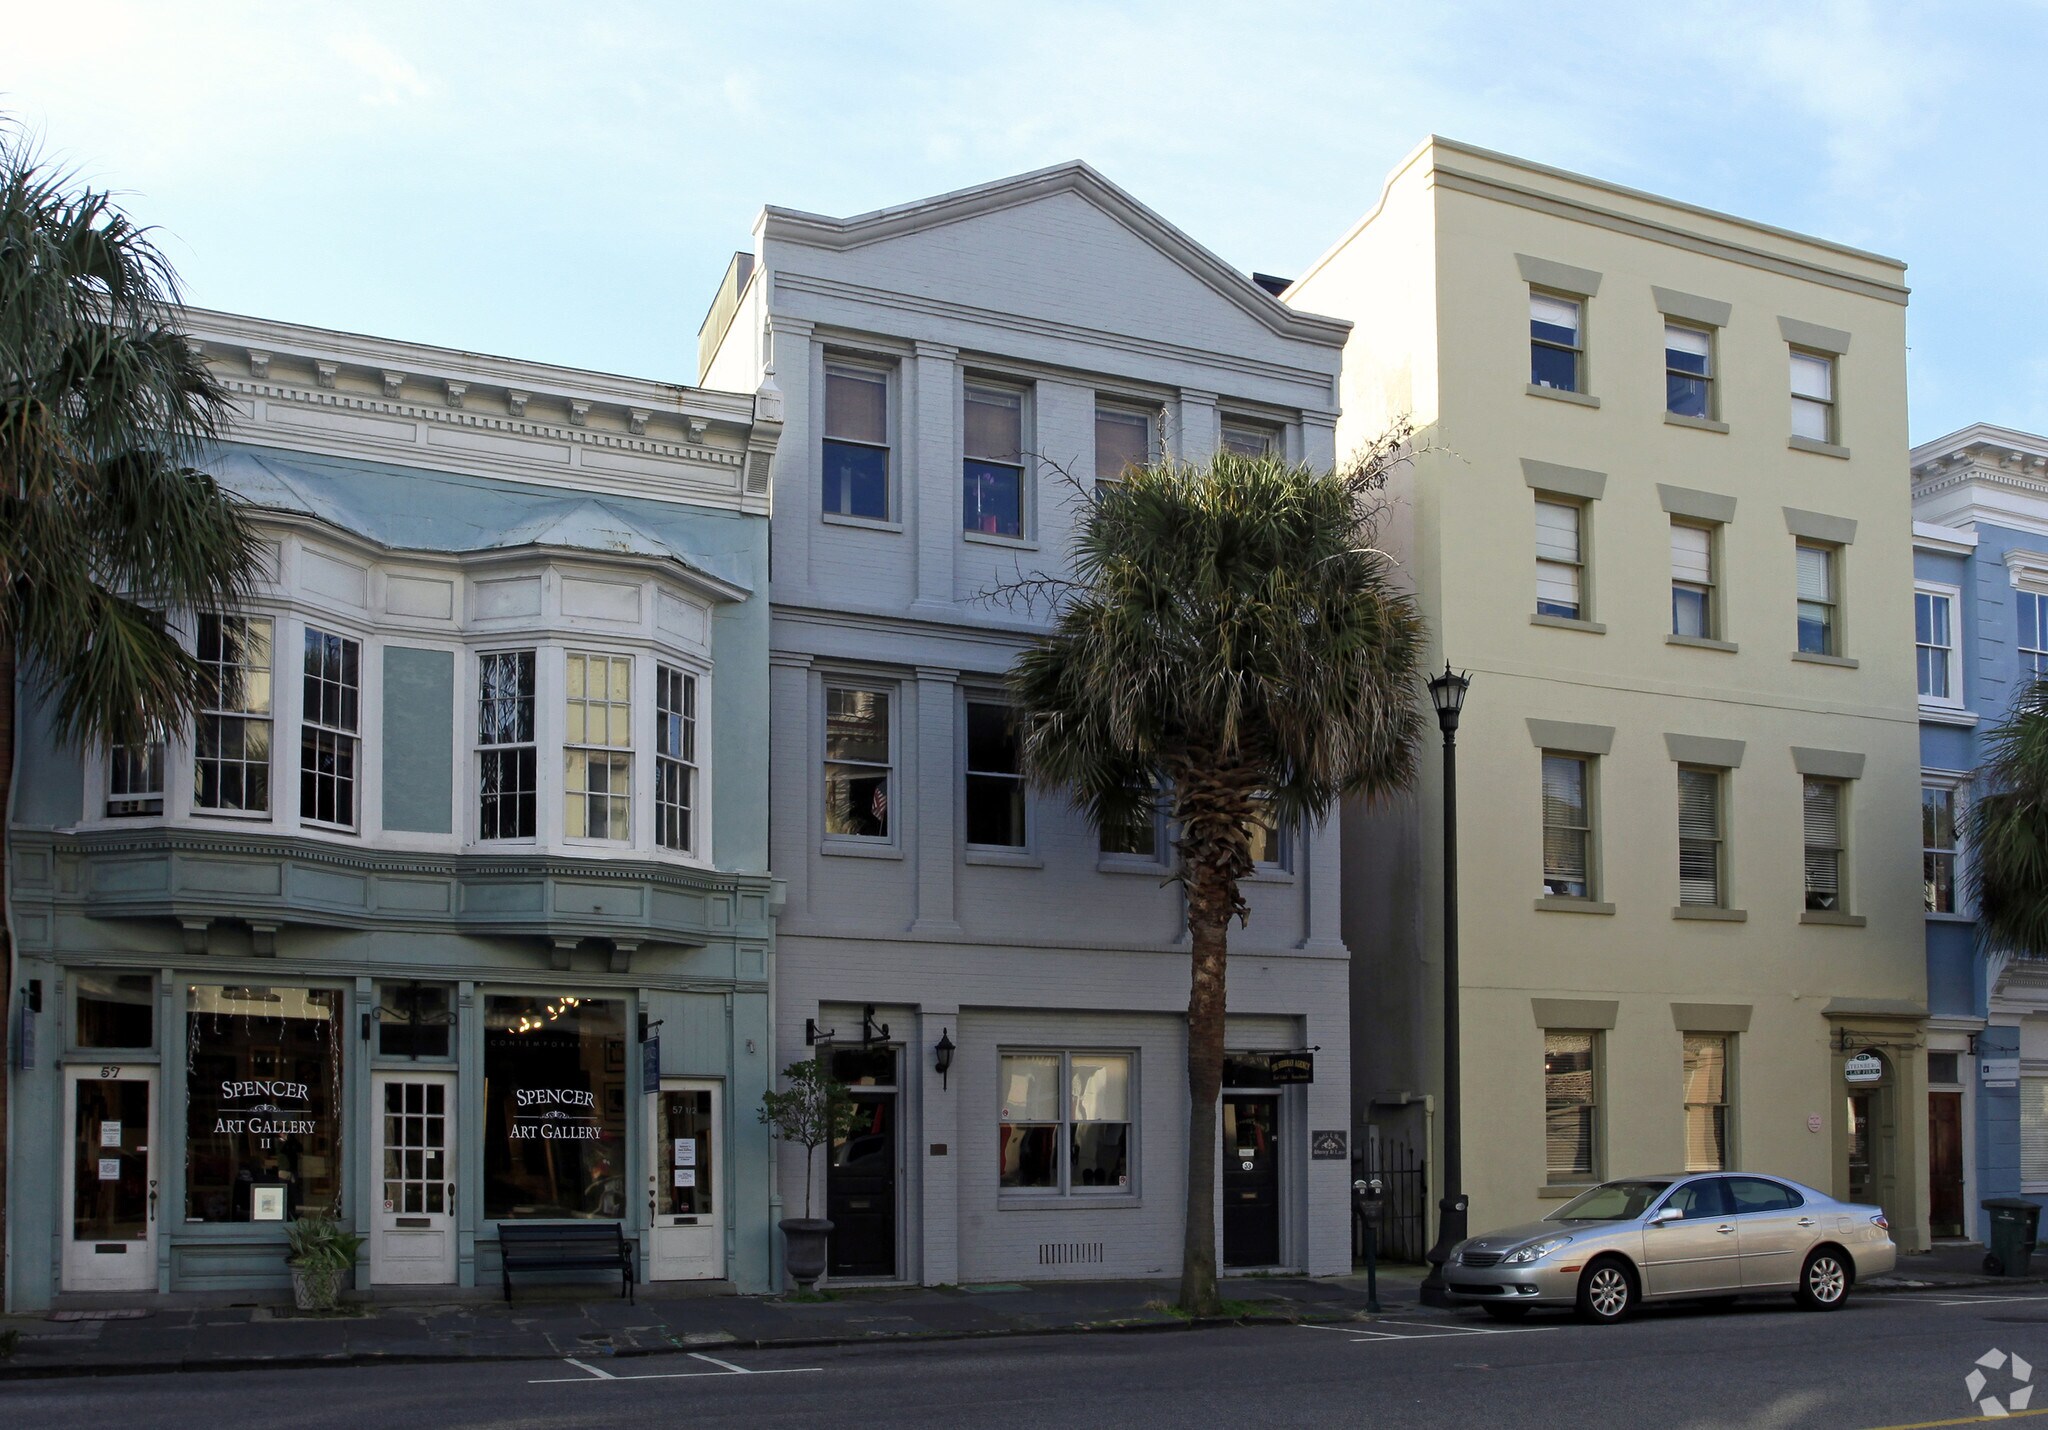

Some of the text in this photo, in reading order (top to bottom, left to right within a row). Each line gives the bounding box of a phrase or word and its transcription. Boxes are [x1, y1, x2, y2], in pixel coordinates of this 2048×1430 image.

[101, 1066, 120, 1078] 57
[221, 1080, 309, 1102] SPENCER
[516, 1088, 595, 1109] SPENCER
[672, 1105, 697, 1114] 57 1/2
[213, 1117, 316, 1135] ART GALLERY
[509, 1123, 602, 1140] ART GALLERY
[260, 1138, 271, 1149] II
